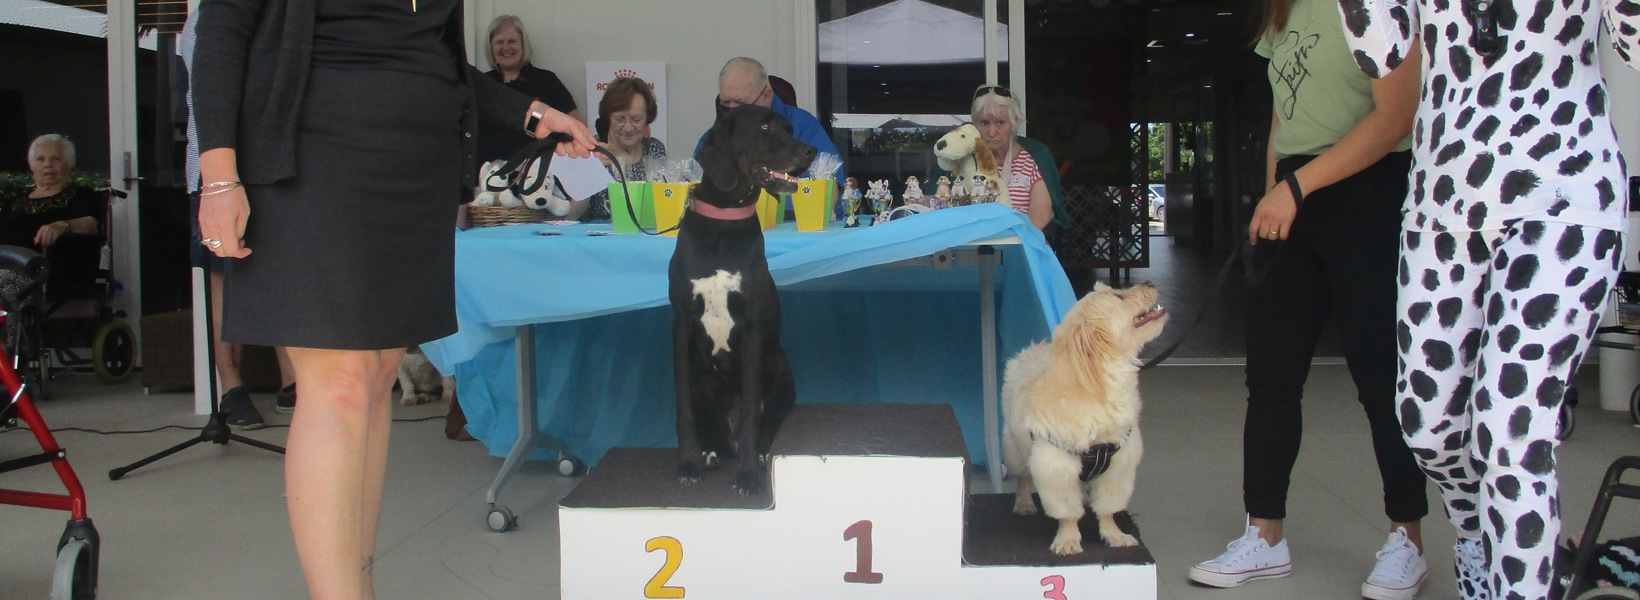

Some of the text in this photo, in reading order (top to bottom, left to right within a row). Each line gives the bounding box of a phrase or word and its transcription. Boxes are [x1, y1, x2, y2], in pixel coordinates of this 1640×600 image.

[644, 535, 685, 599] 2
[843, 519, 883, 584] 1
[1040, 574, 1067, 600] 3
